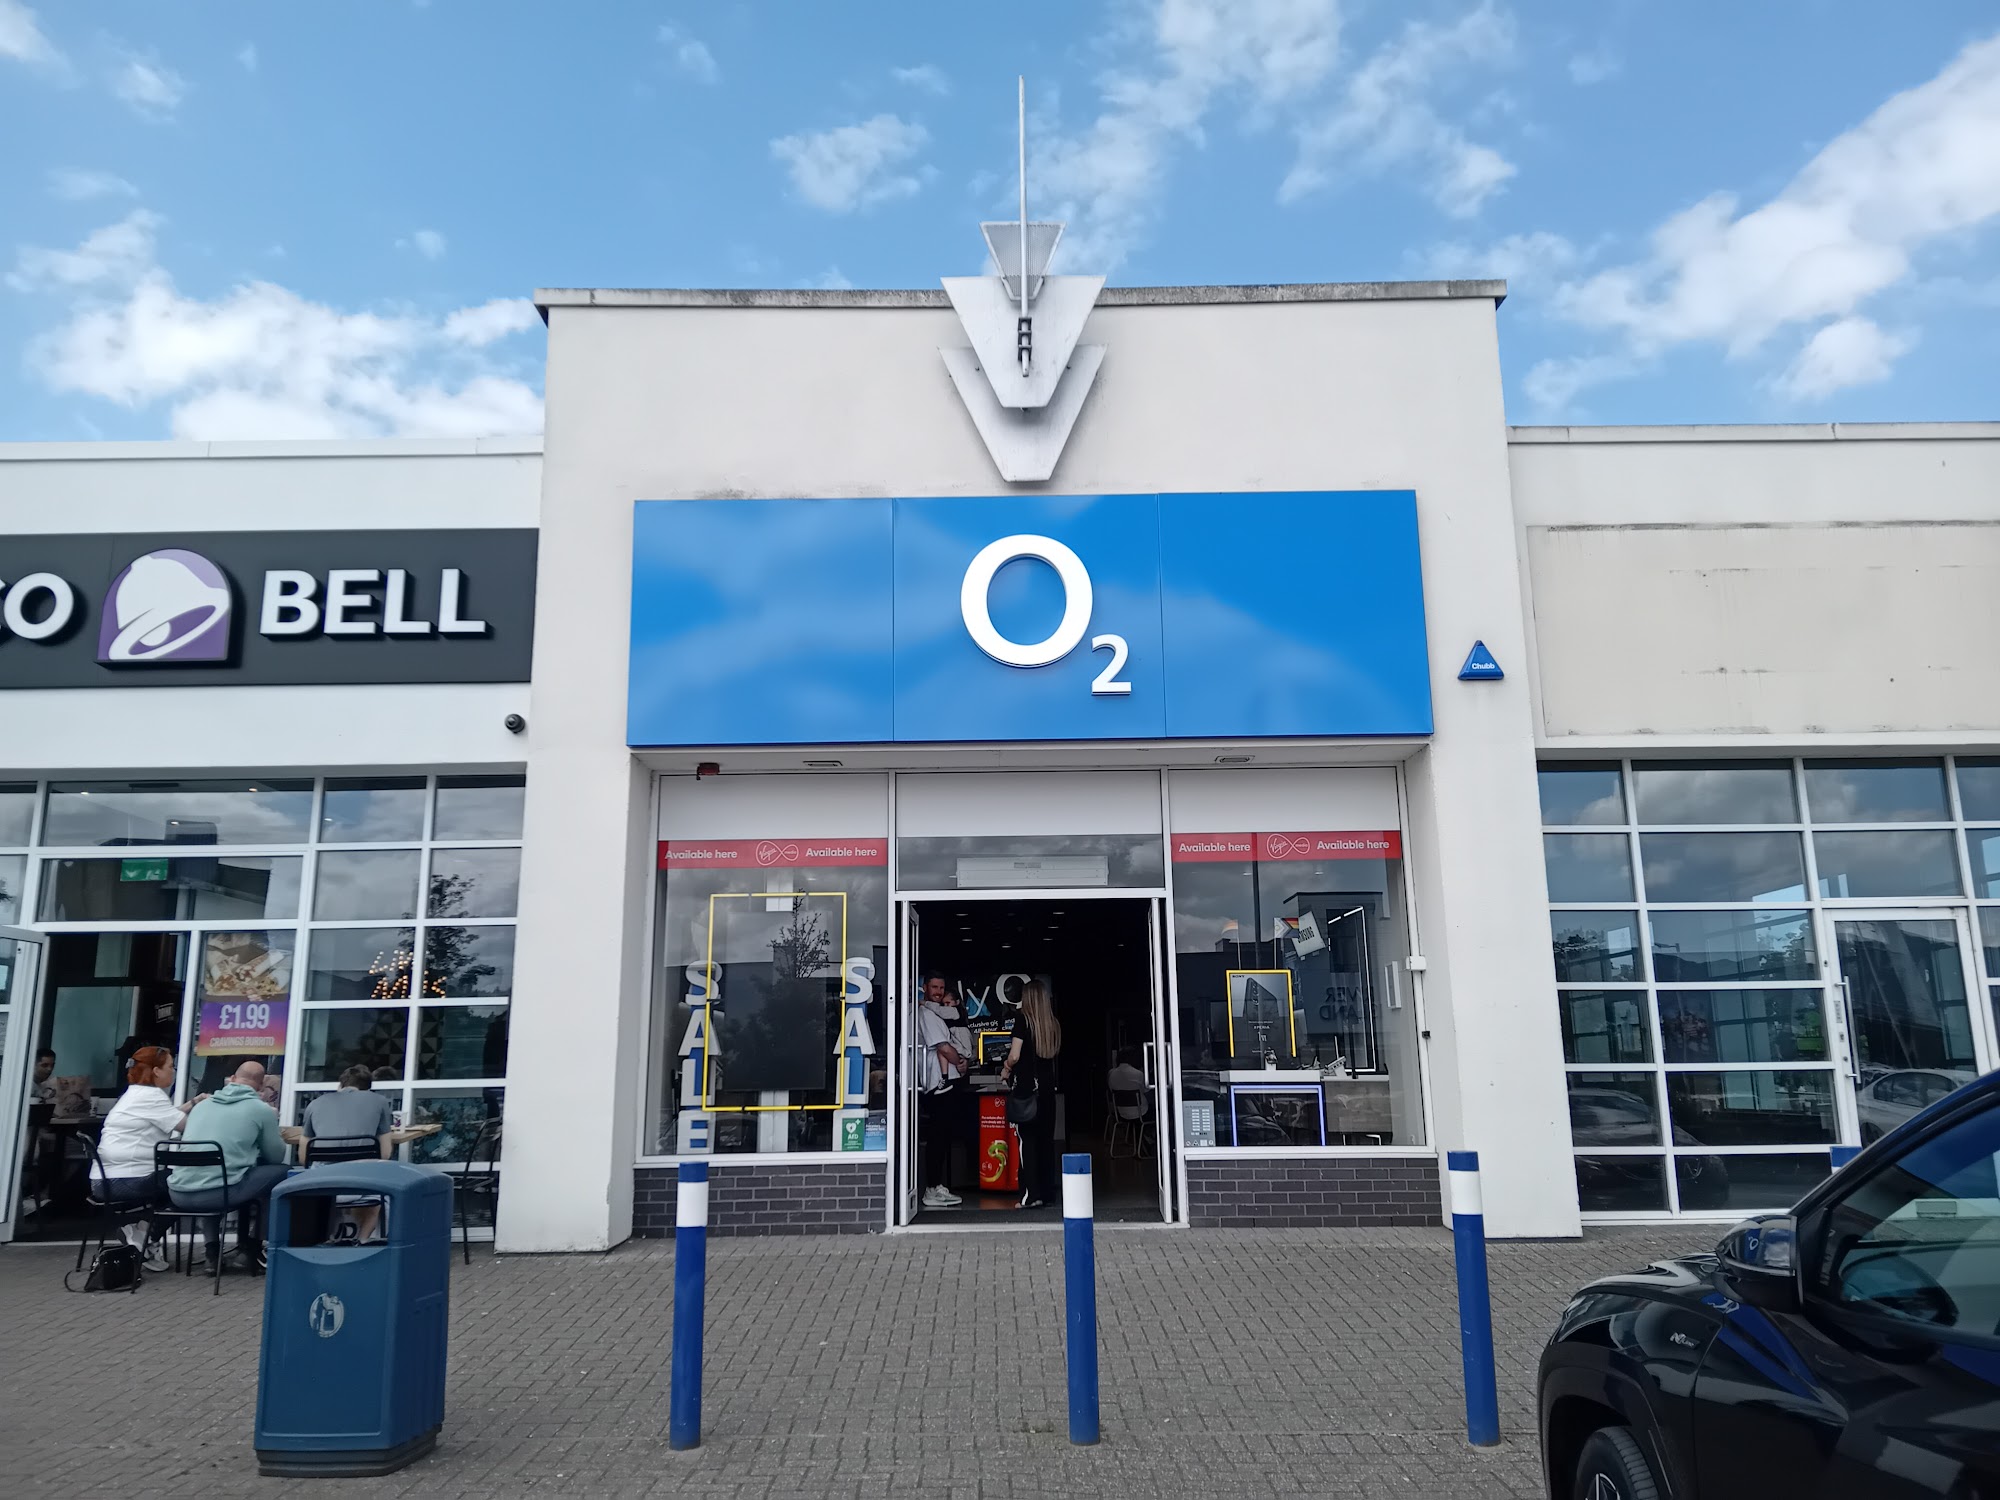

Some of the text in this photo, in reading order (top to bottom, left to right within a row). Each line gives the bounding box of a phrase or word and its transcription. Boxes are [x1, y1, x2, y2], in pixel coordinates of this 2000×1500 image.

[0, 569, 486, 639] O BELL
[1472, 662, 1495, 670] Chubb
[1179, 843, 1251, 853] Available here
[1317, 840, 1390, 850] Available here
[665, 850, 738, 860] Available here
[806, 847, 878, 857] Available here
[218, 1004, 270, 1030] £1.99
[209, 1036, 275, 1047] CRAVINGS BURRITO
[676, 960, 723, 1154] SALE
[334, 1222, 358, 1239] JD
